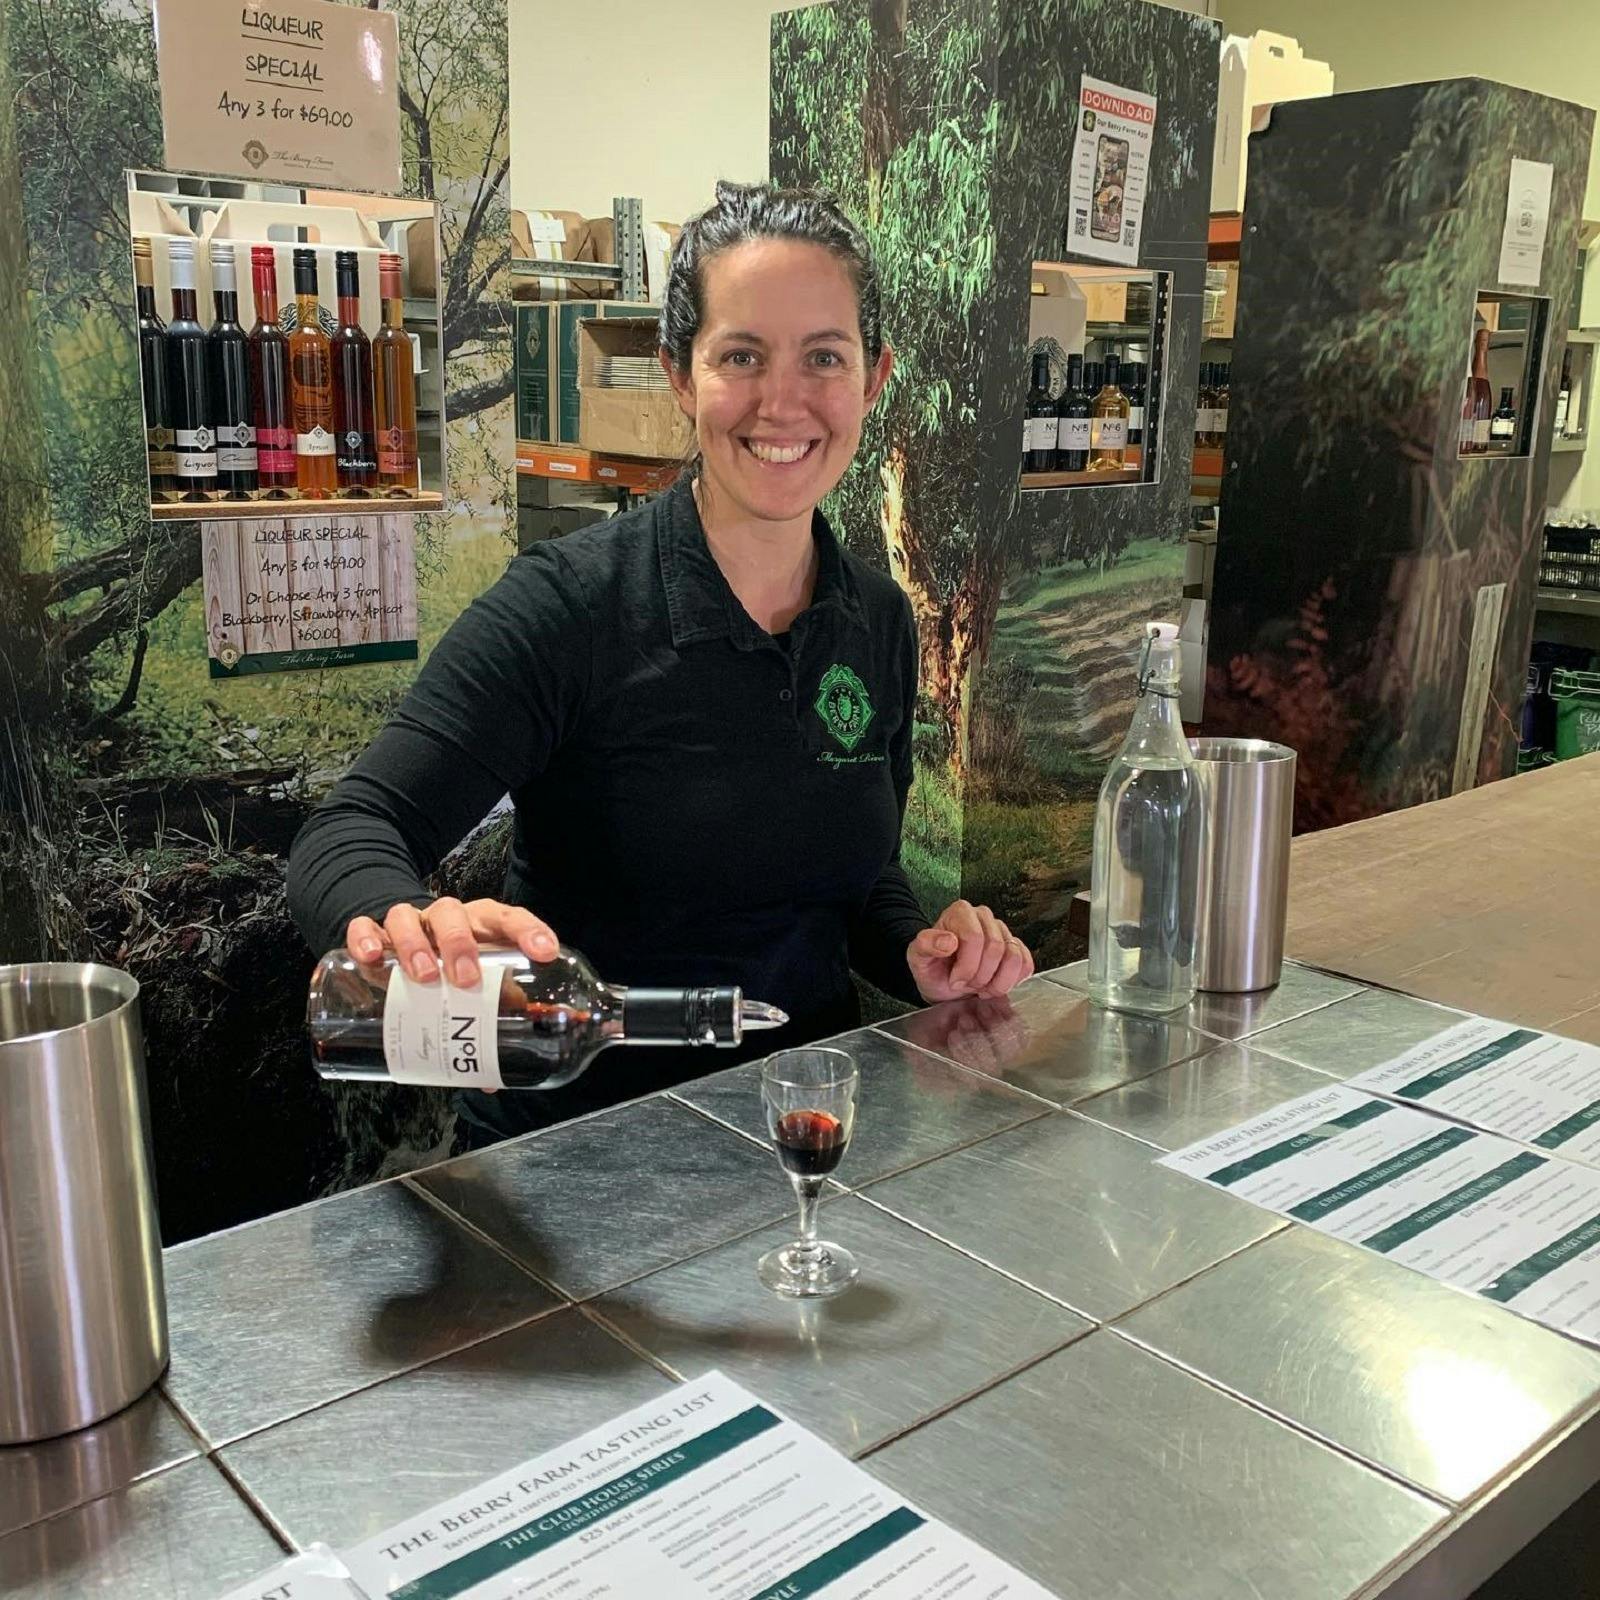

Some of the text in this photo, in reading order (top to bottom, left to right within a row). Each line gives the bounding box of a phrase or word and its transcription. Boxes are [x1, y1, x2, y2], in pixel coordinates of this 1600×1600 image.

[242, 8, 324, 41] LIQUEUR
[246, 53, 324, 84] SPECIAL
[218, 90, 353, 128] Any 3 for $69.00
[1085, 90, 1152, 122] DOWNLOAD
[1108, 121, 1121, 132] Berry
[1122, 126, 1137, 135] Farm
[338, 458, 376, 470] Blackberry
[255, 525, 369, 543] LIQUEUR SPECIAL
[261, 556, 366, 577] Any 3 for $69.00
[246, 583, 381, 605] Or Choose Any 3 from
[222, 612, 289, 627] Blackberry,
[363, 602, 403, 620] Apricot
[297, 627, 341, 641] $60.00
[1179, 1150, 1206, 1163] THE
[1207, 1134, 1243, 1152] BERRY
[1243, 1122, 1275, 1139] FARM
[379, 1391, 717, 1560] THE BERRY FARM TASTING LIST
[501, 1527, 540, 1550] THE
[539, 1502, 583, 1532] CLUB
[583, 1475, 639, 1509] HOUSE
[637, 1450, 686, 1482] SERIES
[579, 1525, 605, 1545] $25
[605, 1511, 634, 1533] EACH
